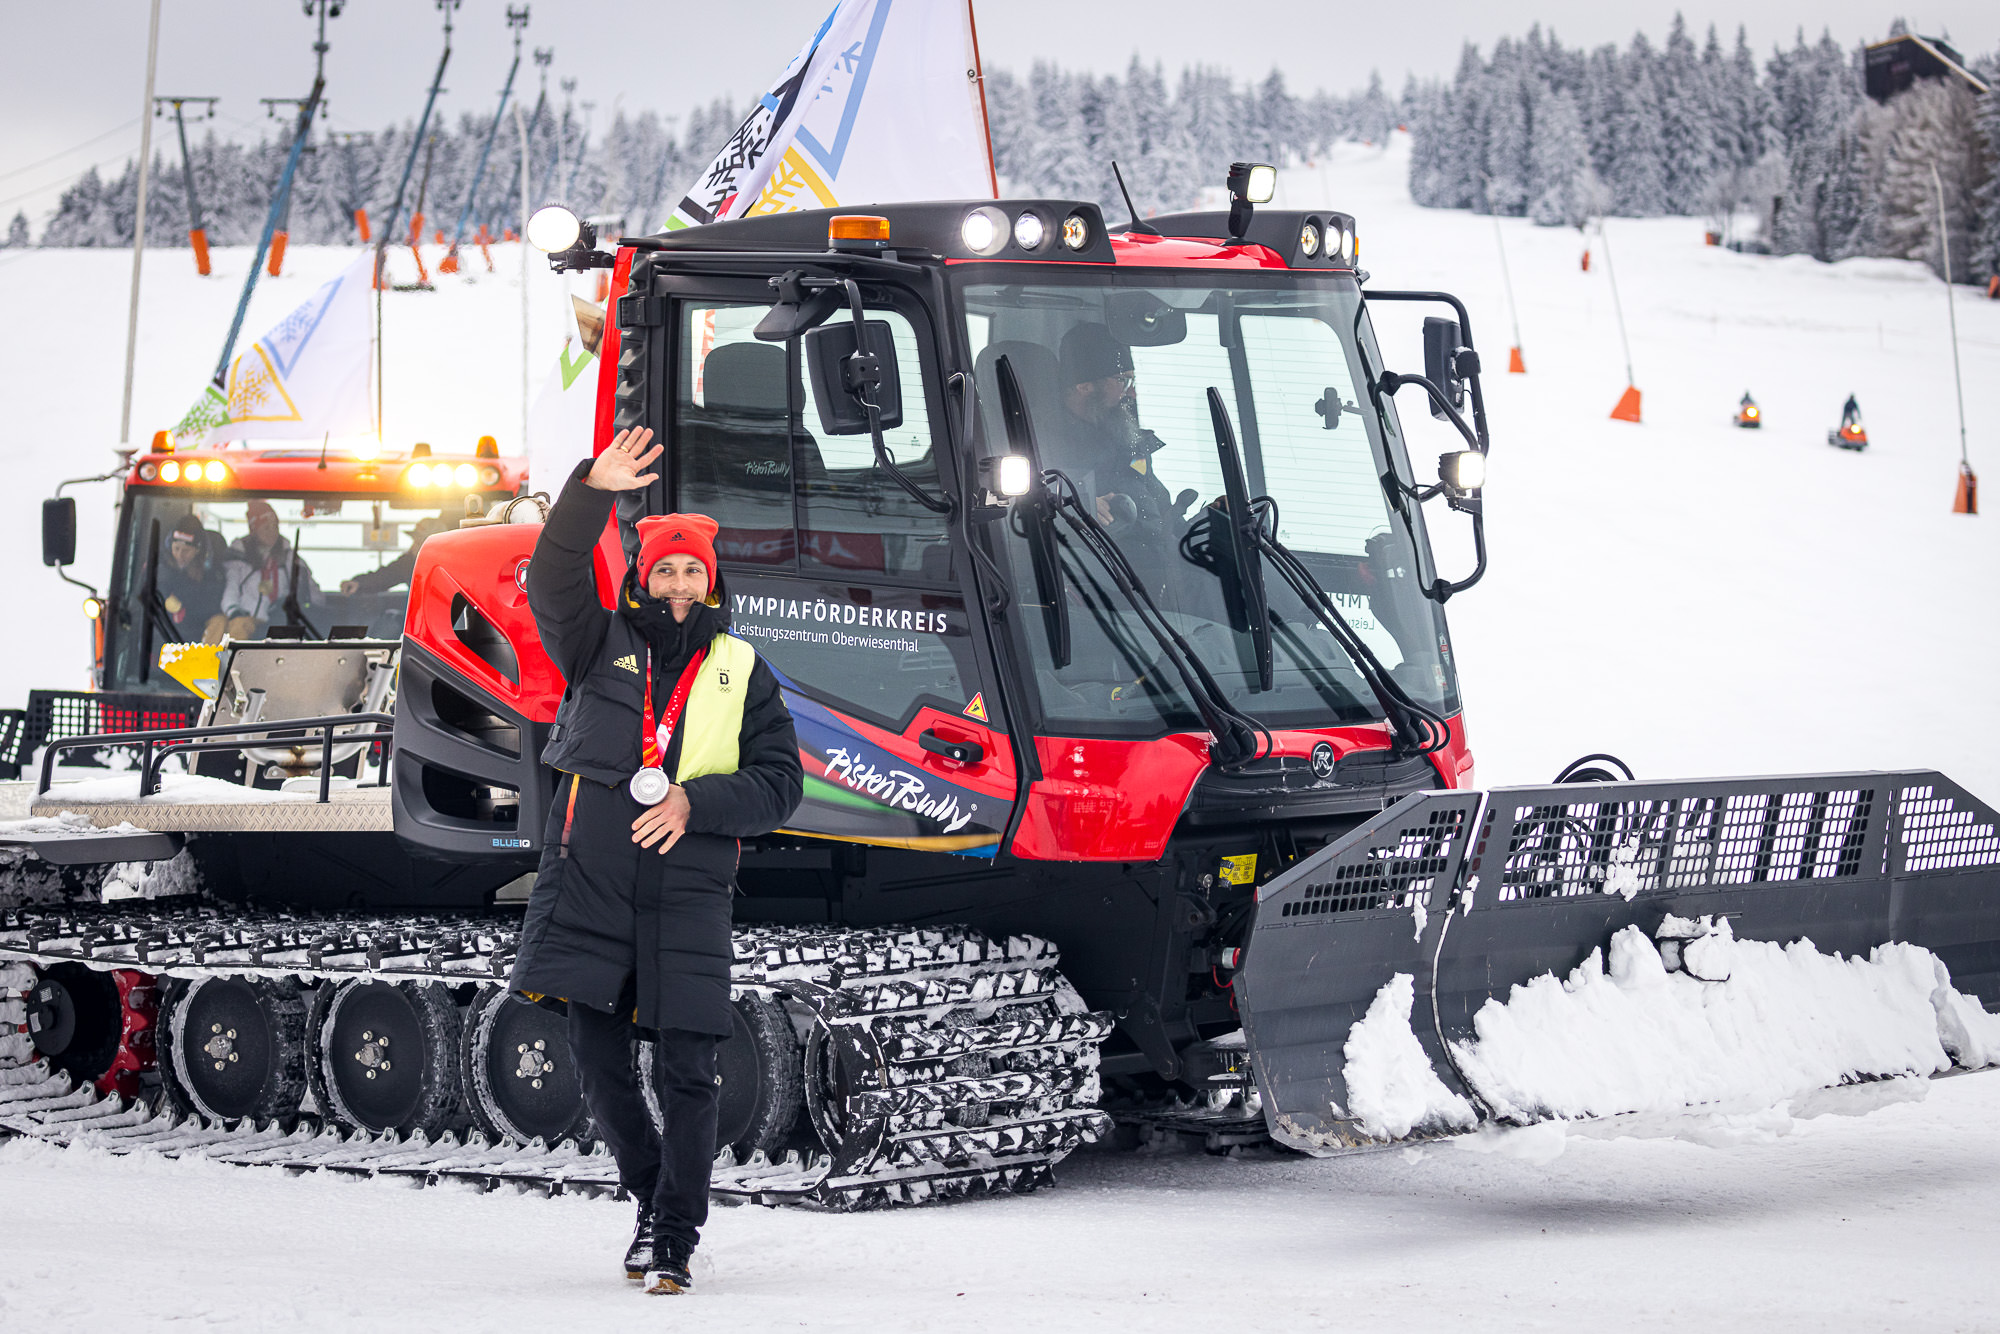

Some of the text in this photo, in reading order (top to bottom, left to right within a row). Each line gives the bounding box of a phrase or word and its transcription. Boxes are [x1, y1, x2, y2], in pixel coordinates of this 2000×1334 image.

[731, 594, 947, 633] YMPIAFÖRDERKREIS
[733, 620, 919, 652] Leistungszentrum Oberwiesenthal
[613, 659, 640, 674] adidas
[824, 747, 972, 834] PistenBully
[492, 838, 531, 848] BLUEIQ
